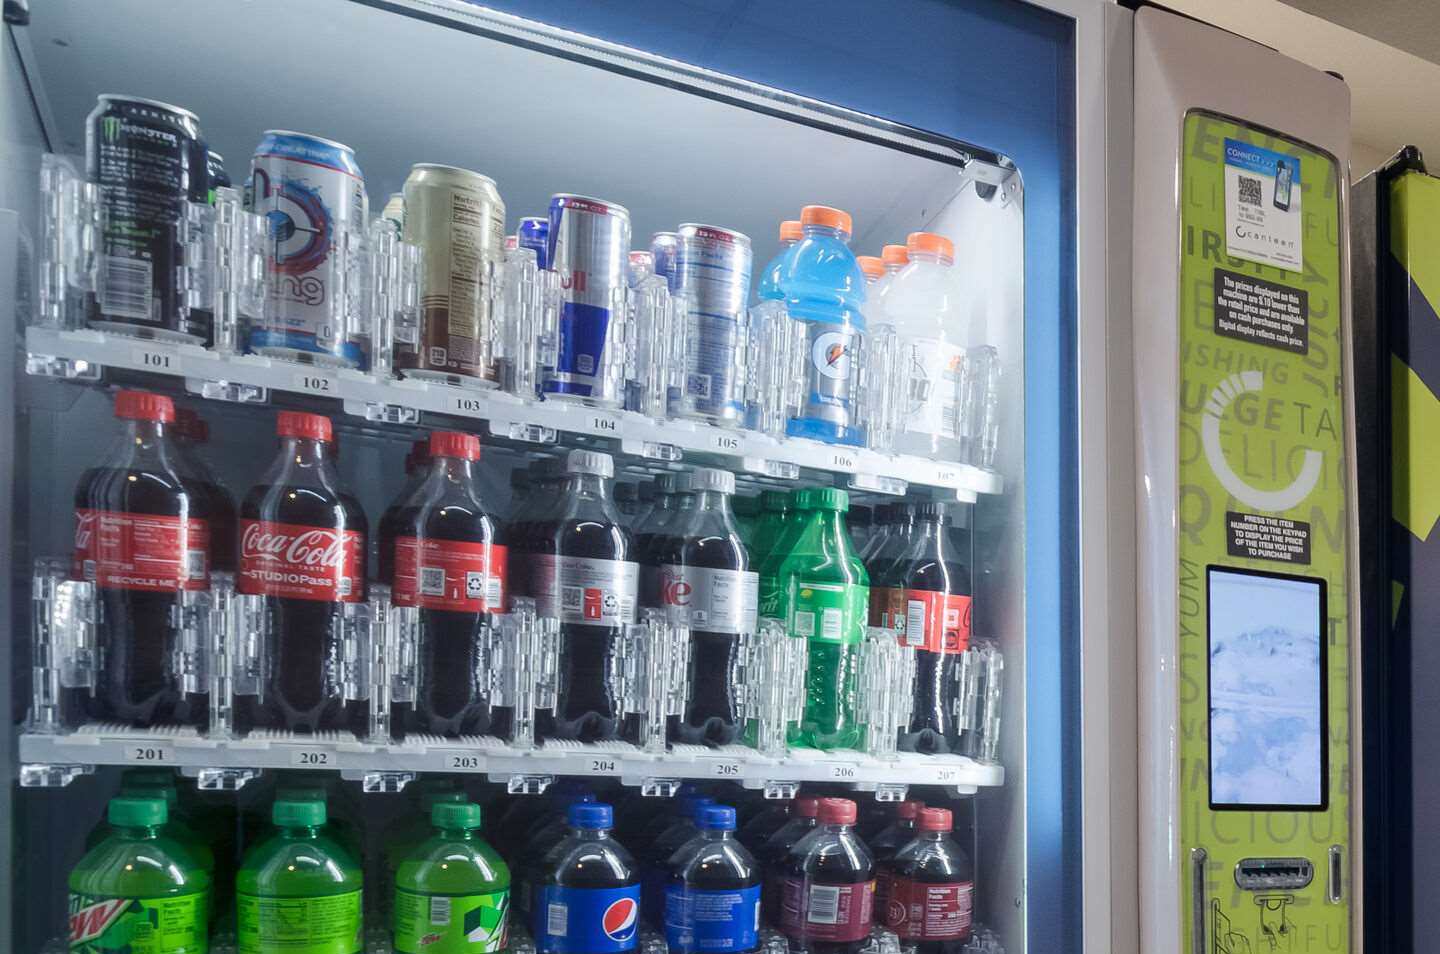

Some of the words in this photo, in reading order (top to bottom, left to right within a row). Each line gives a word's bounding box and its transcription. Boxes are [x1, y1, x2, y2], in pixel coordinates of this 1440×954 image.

[1246, 231, 1294, 249] canteen
[143, 353, 171, 369] 101
[303, 377, 329, 392] 102
[456, 399, 481, 412] 103
[593, 418, 616, 432] 104
[716, 437, 738, 450] 105
[833, 455, 853, 468] 106
[937, 471, 955, 481] 107
[241, 523, 352, 565] Coca-Cola
[136, 748, 165, 762] 201
[300, 752, 328, 766] 202
[453, 756, 479, 769] 203
[592, 760, 616, 773] 204
[717, 763, 739, 776] 205
[834, 767, 855, 779] 206
[937, 770, 956, 782] 207
